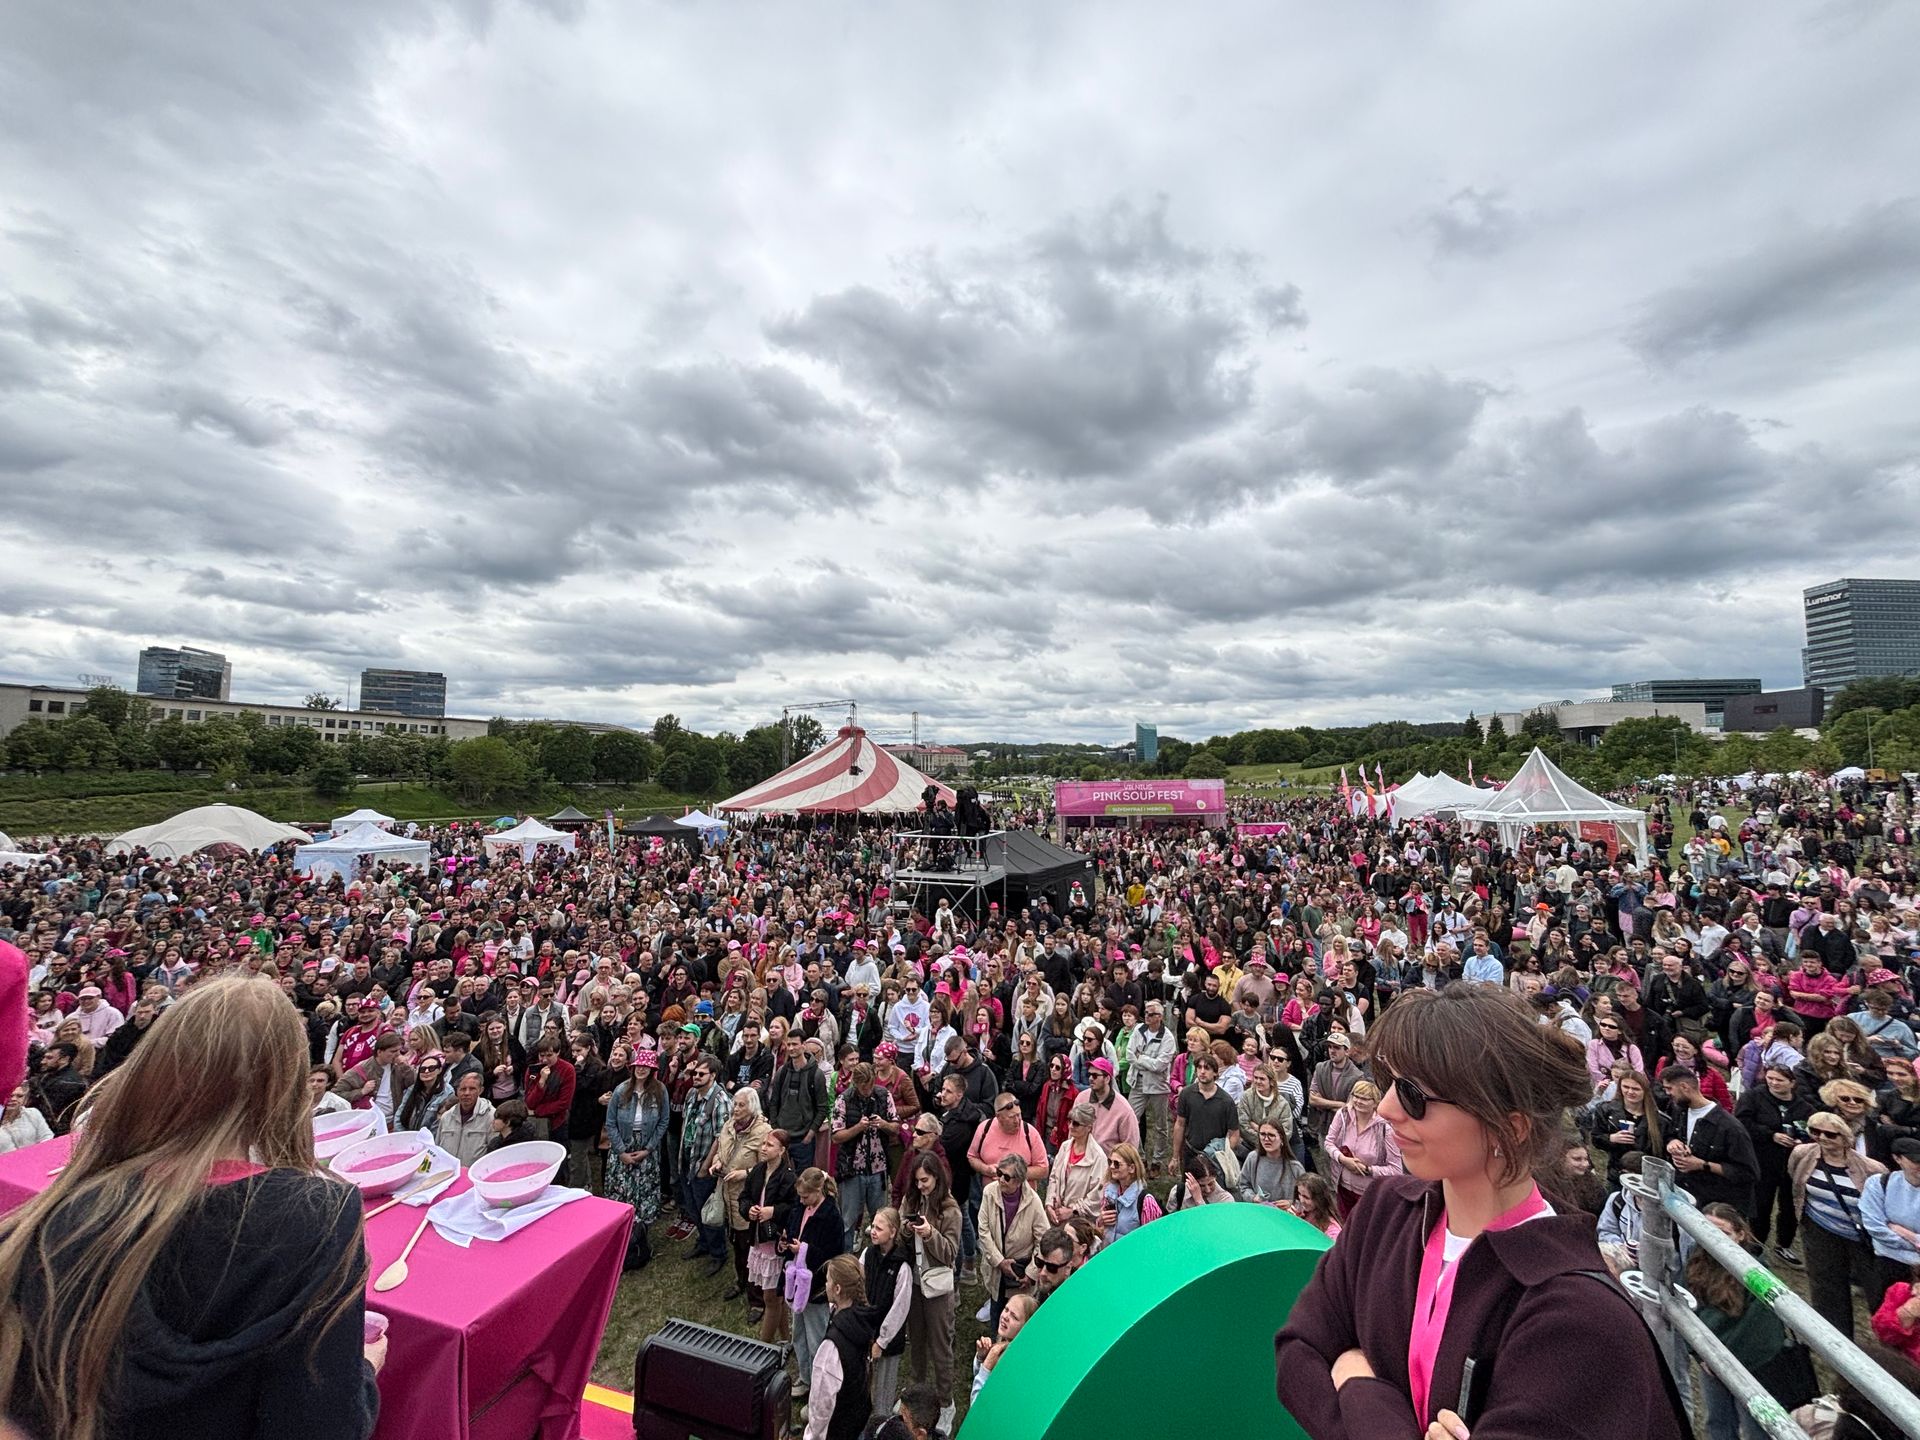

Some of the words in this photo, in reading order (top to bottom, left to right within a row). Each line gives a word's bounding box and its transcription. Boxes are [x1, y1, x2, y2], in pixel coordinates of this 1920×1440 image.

[1806, 592, 1842, 606] Luminor
[1093, 791, 1121, 801] PINK
[1122, 790, 1156, 801] SOUP
[1157, 790, 1185, 800] FEST
